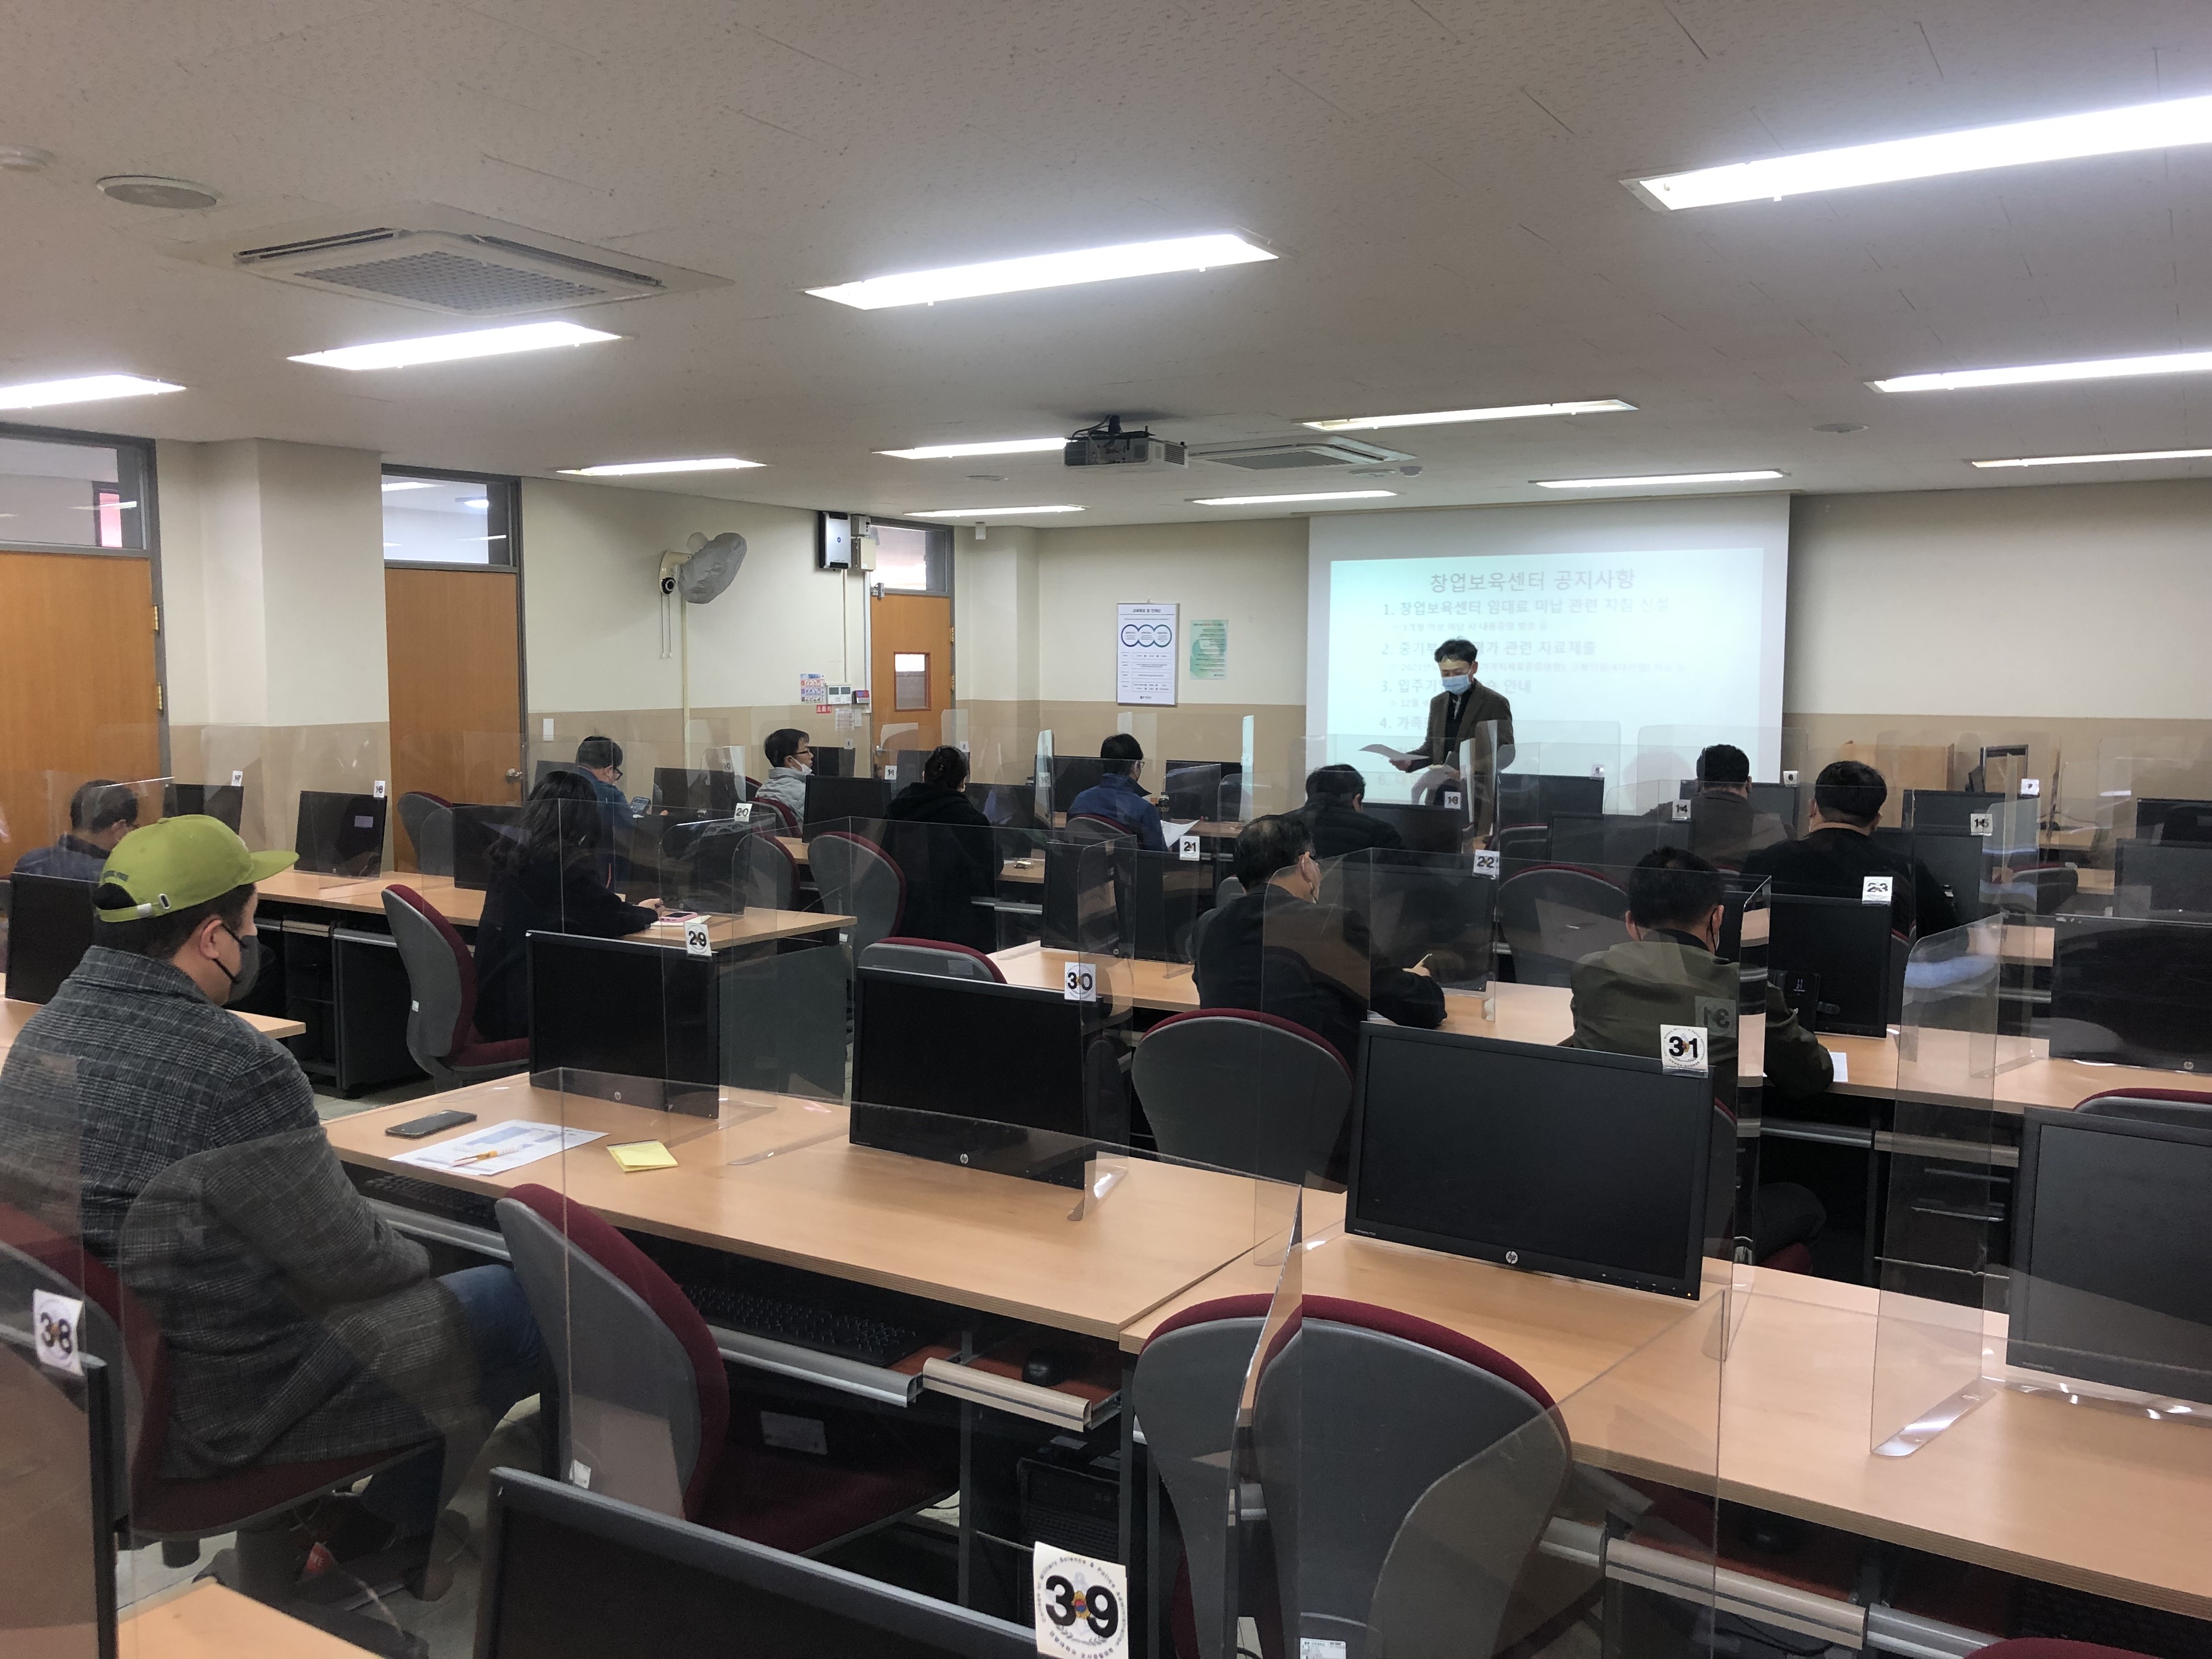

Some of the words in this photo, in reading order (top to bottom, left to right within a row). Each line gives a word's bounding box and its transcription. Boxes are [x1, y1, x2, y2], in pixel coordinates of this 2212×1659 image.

[1430, 571, 1545, 593] 창업보육센터
[1554, 568, 1635, 591] 공지사항
[1384, 604, 1394, 616] 1.
[1400, 600, 1481, 616] 창업보육센터
[1488, 600, 1529, 614] 임대료
[1535, 599, 1563, 614] 미납
[1570, 599, 1598, 613] 관련
[1382, 644, 1393, 654] 2.
[1504, 641, 1532, 655] 관련
[1381, 681, 1392, 692] 3.
[1398, 679, 1443, 693] 입주기
[1503, 679, 1532, 693] 안내
[1379, 717, 1391, 729] 4.
[736, 808, 749, 817] 20
[1676, 804, 1688, 813] 14
[1974, 818, 1989, 828] 15
[1184, 841, 1197, 853] 21
[1477, 855, 1494, 868] 22
[1867, 882, 1888, 893] 23
[689, 930, 707, 947] 29
[1068, 972, 1092, 991] 30
[1668, 1036, 1697, 1058] 31
[1505, 1251, 1518, 1264] hp
[40, 1312, 72, 1355] 38
[1046, 1575, 1119, 1638] 39
